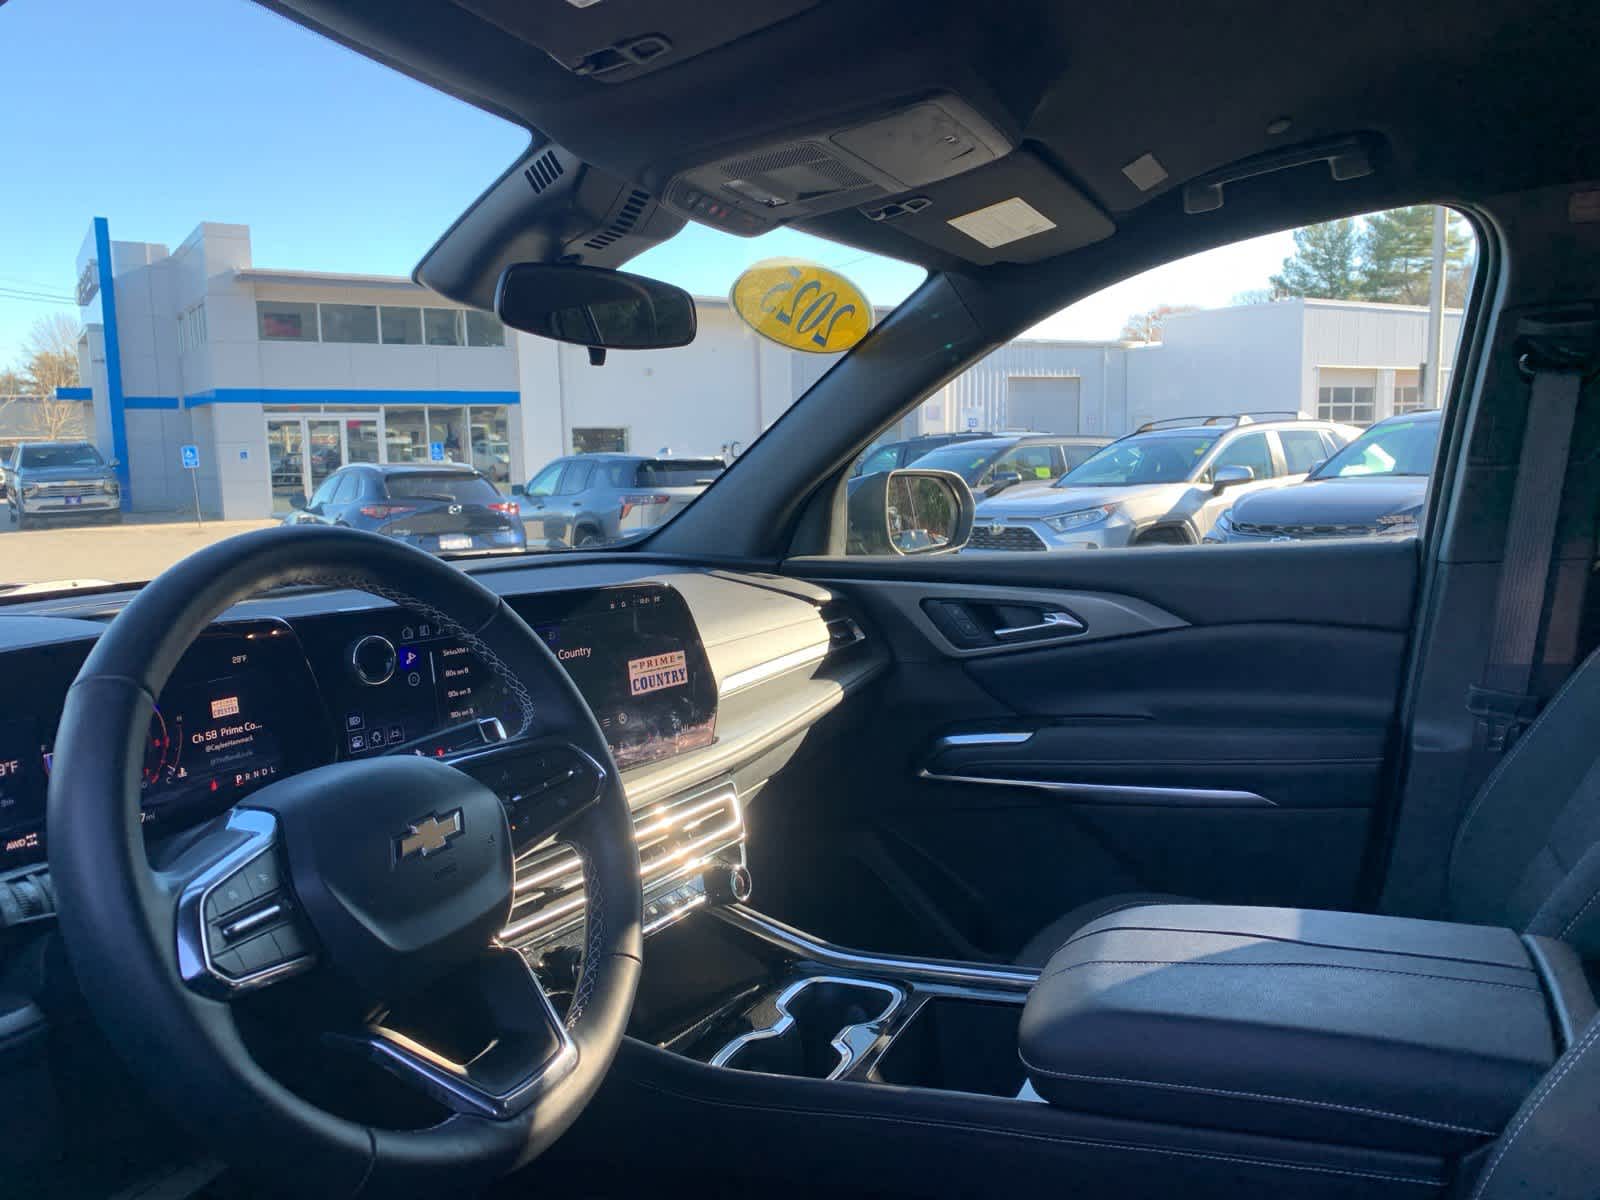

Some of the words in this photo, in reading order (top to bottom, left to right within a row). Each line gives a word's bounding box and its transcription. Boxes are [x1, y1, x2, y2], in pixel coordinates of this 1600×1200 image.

[558, 647, 592, 660] Country
[639, 655, 676, 669] PRIME
[632, 668, 686, 692] COUNTRY
[192, 732, 204, 744] Ch
[205, 730, 217, 741] 58
[220, 725, 244, 737] Prime
[6, 838, 26, 851] AWD
